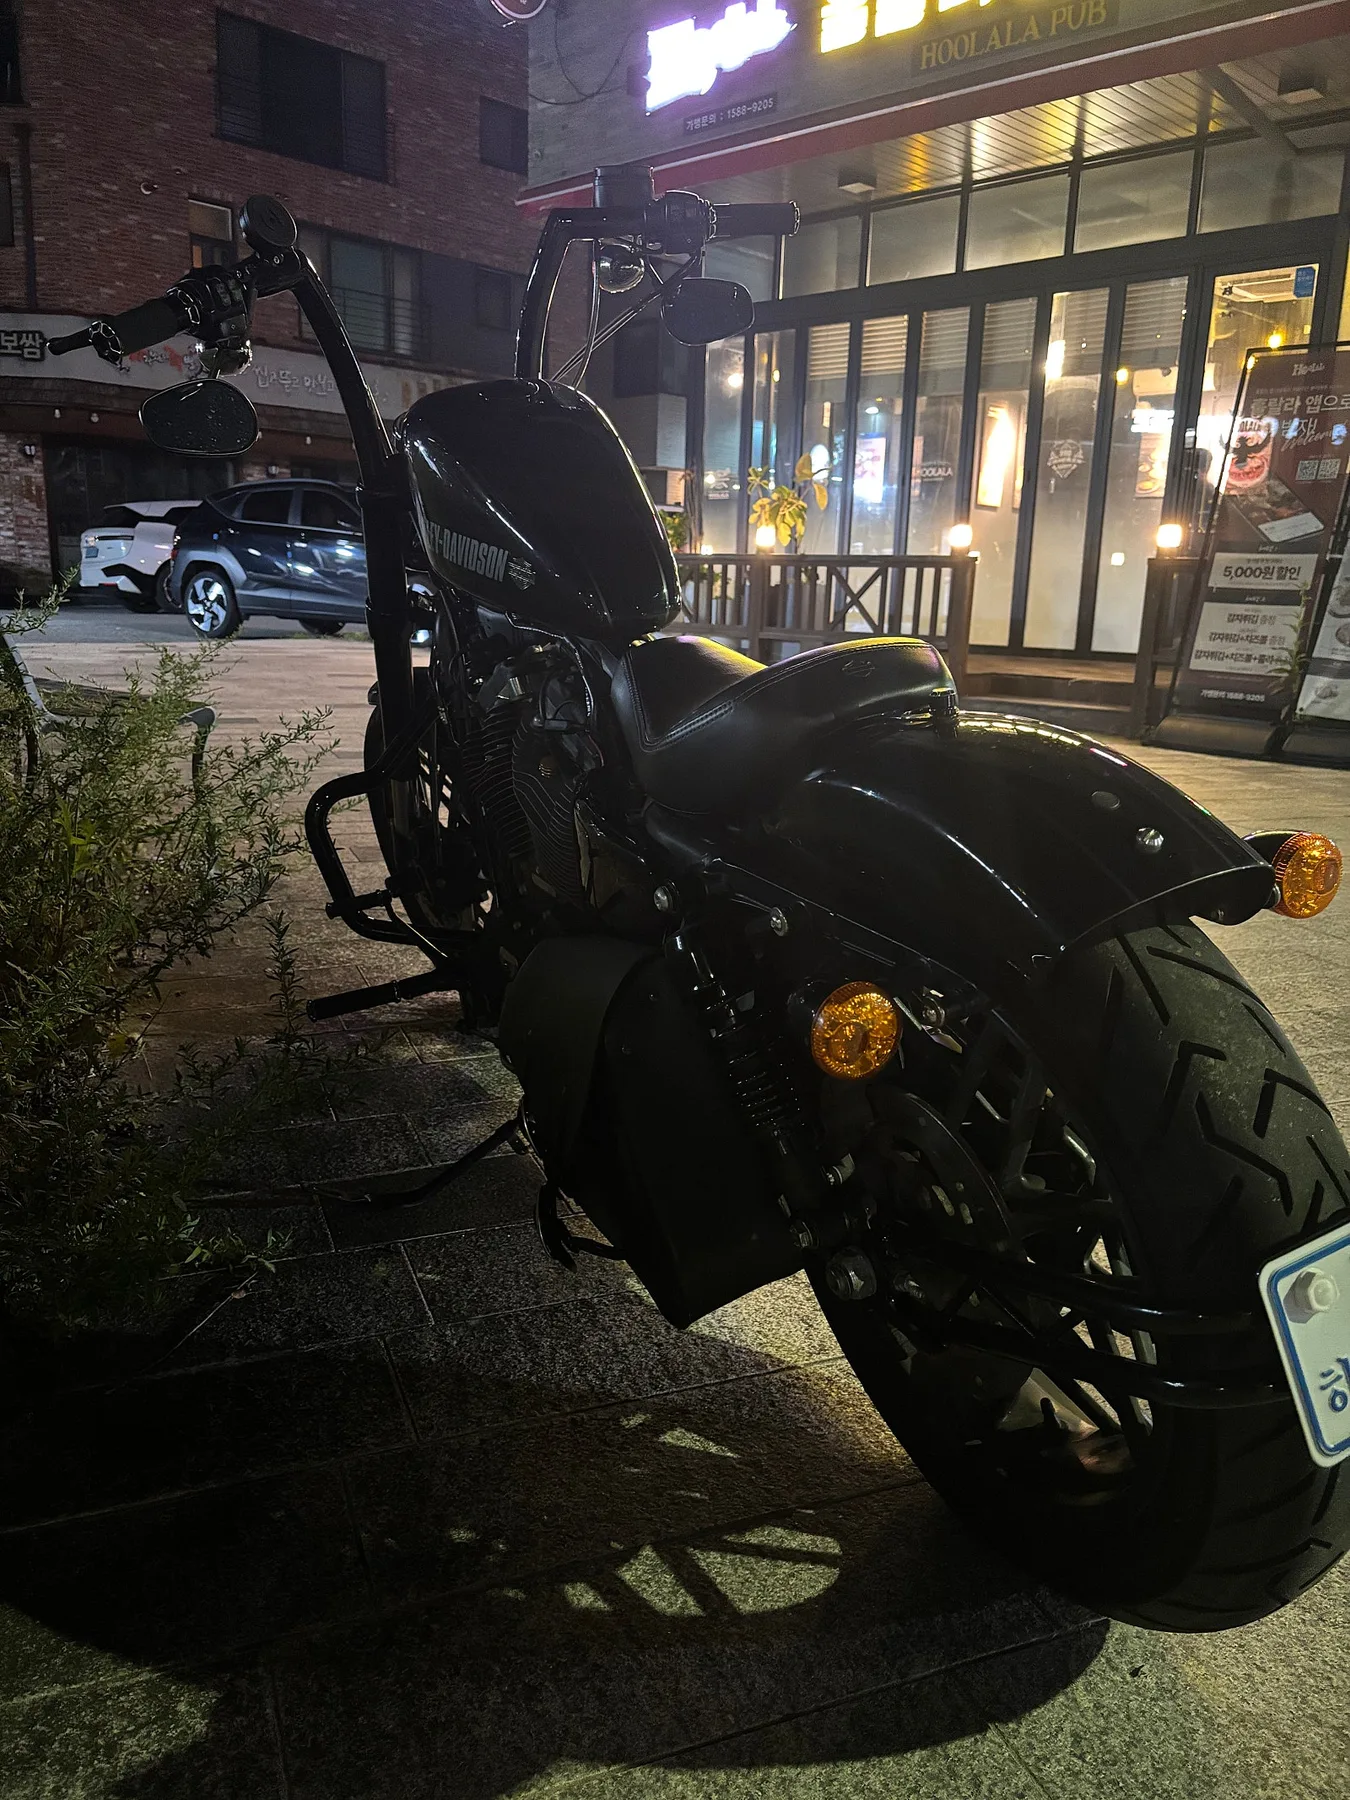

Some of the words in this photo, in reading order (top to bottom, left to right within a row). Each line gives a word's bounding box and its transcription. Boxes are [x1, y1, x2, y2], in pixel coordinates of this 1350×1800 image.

[920, 14, 1041, 70] HOOLALA
[1050, 0, 1108, 36] PUB
[686, 113, 717, 131] 가맹문의
[727, 98, 774, 119] 1588-9205
[0, 332, 43, 359] 보쌈
[1305, 394, 1350, 414] 앱으로
[1223, 566, 1274, 580] 5,000원
[1276, 566, 1301, 581] 할인
